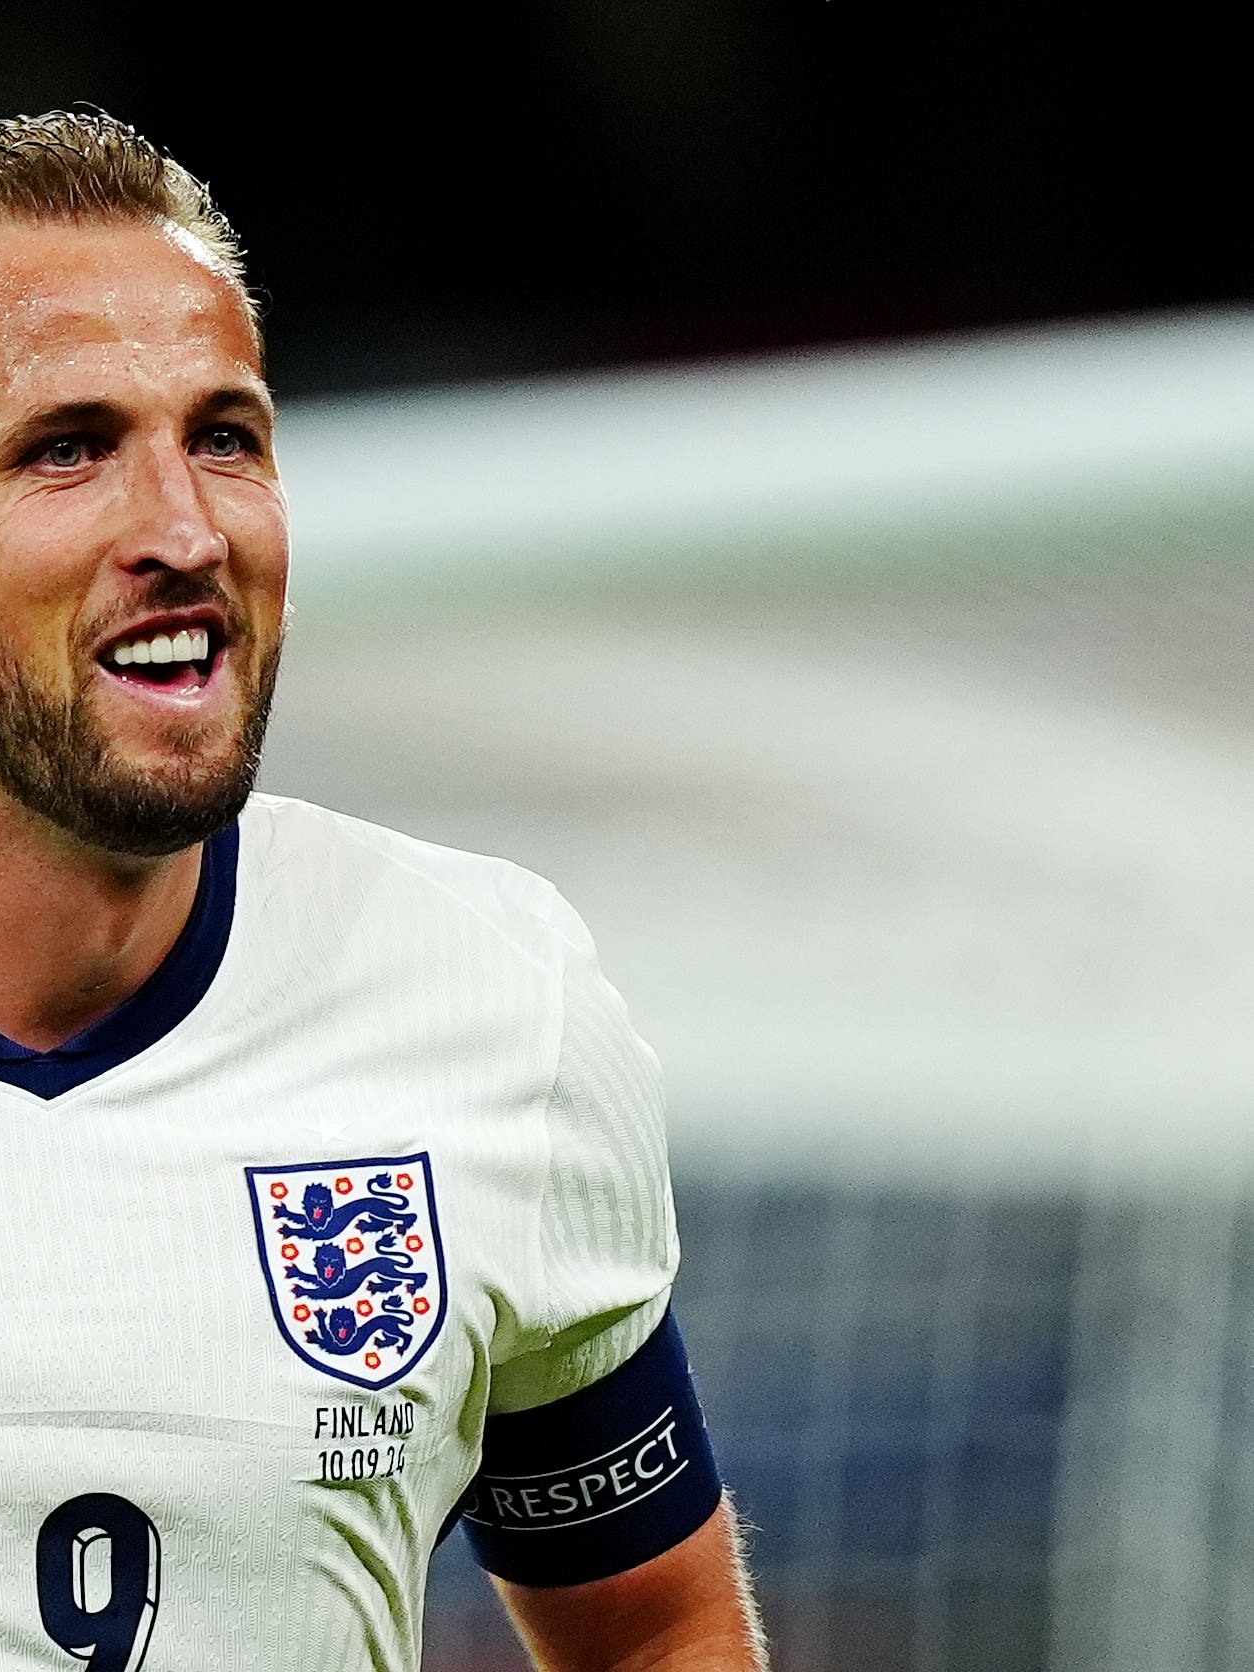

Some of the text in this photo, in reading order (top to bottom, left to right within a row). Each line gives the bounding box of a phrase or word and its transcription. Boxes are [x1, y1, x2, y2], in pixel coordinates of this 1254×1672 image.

[315, 1402, 414, 1438] FINLAND
[318, 1443, 405, 1481] 10.09.24
[491, 1421, 677, 1518] RESPECT
[36, 1492, 161, 1672] 9
